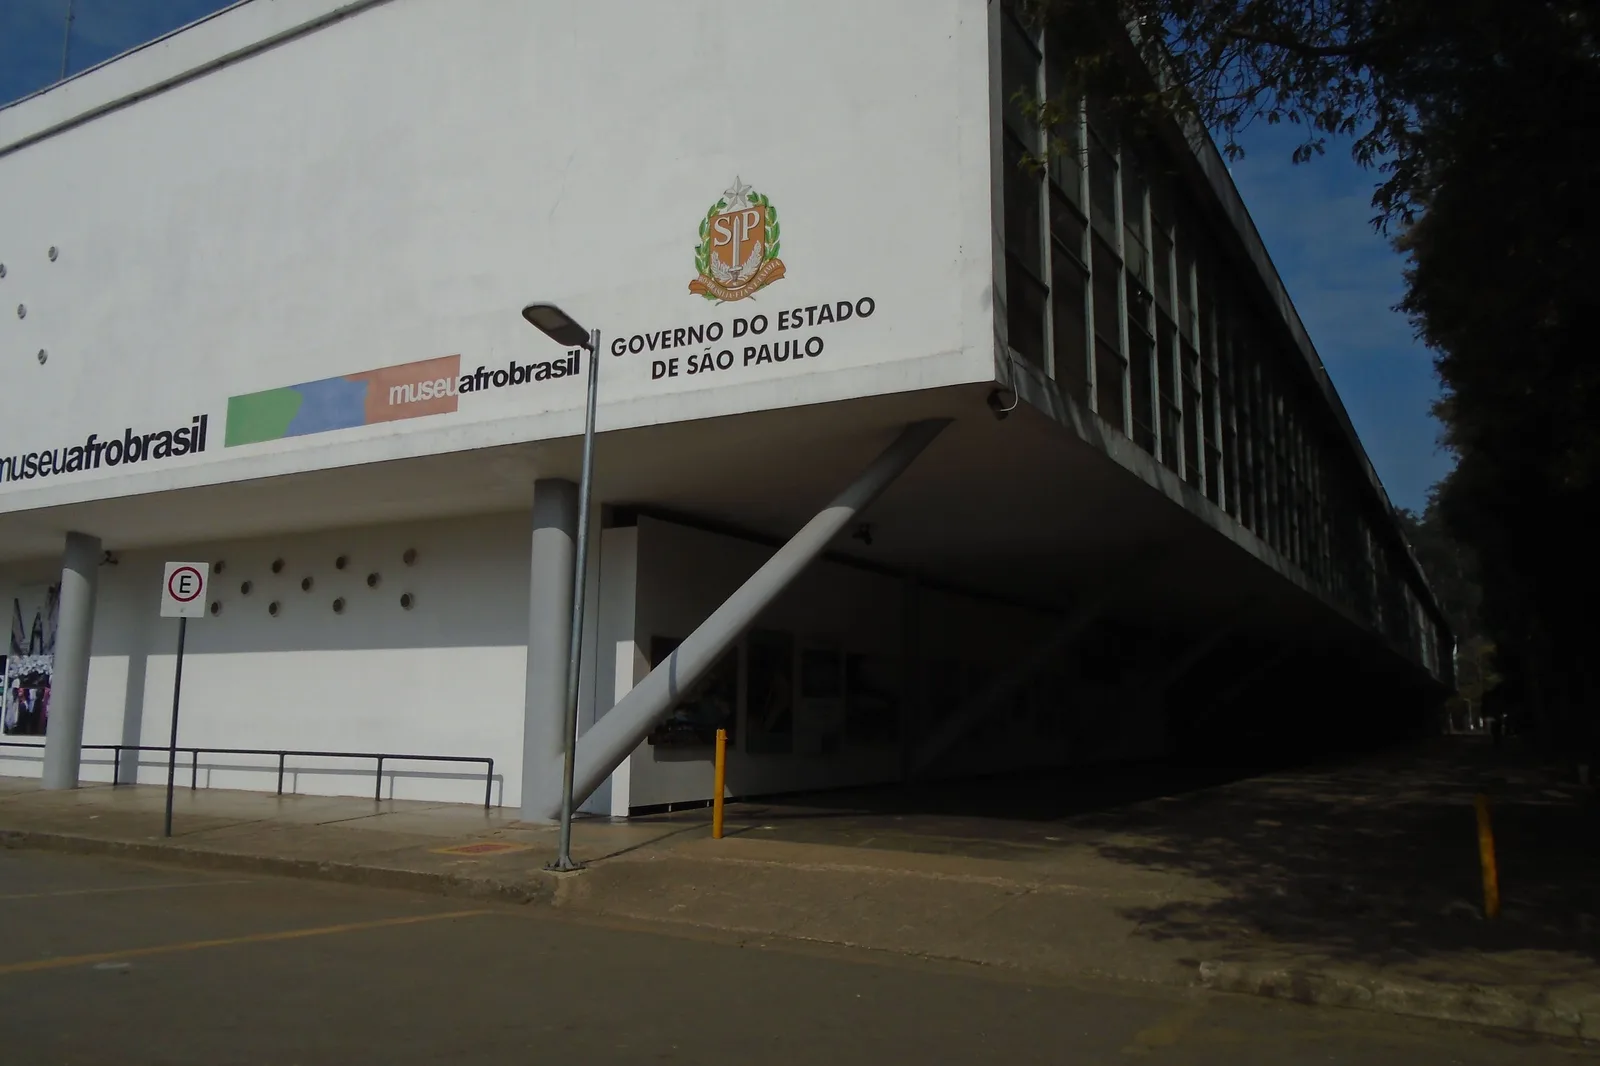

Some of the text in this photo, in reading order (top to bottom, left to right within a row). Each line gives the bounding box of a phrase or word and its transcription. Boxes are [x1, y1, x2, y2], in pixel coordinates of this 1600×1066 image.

[713, 210, 761, 247] SP
[611, 296, 876, 357] GOVERNO DO ESTADO
[651, 336, 825, 381] DE SÃO PAULO
[179, 575, 192, 594] E
